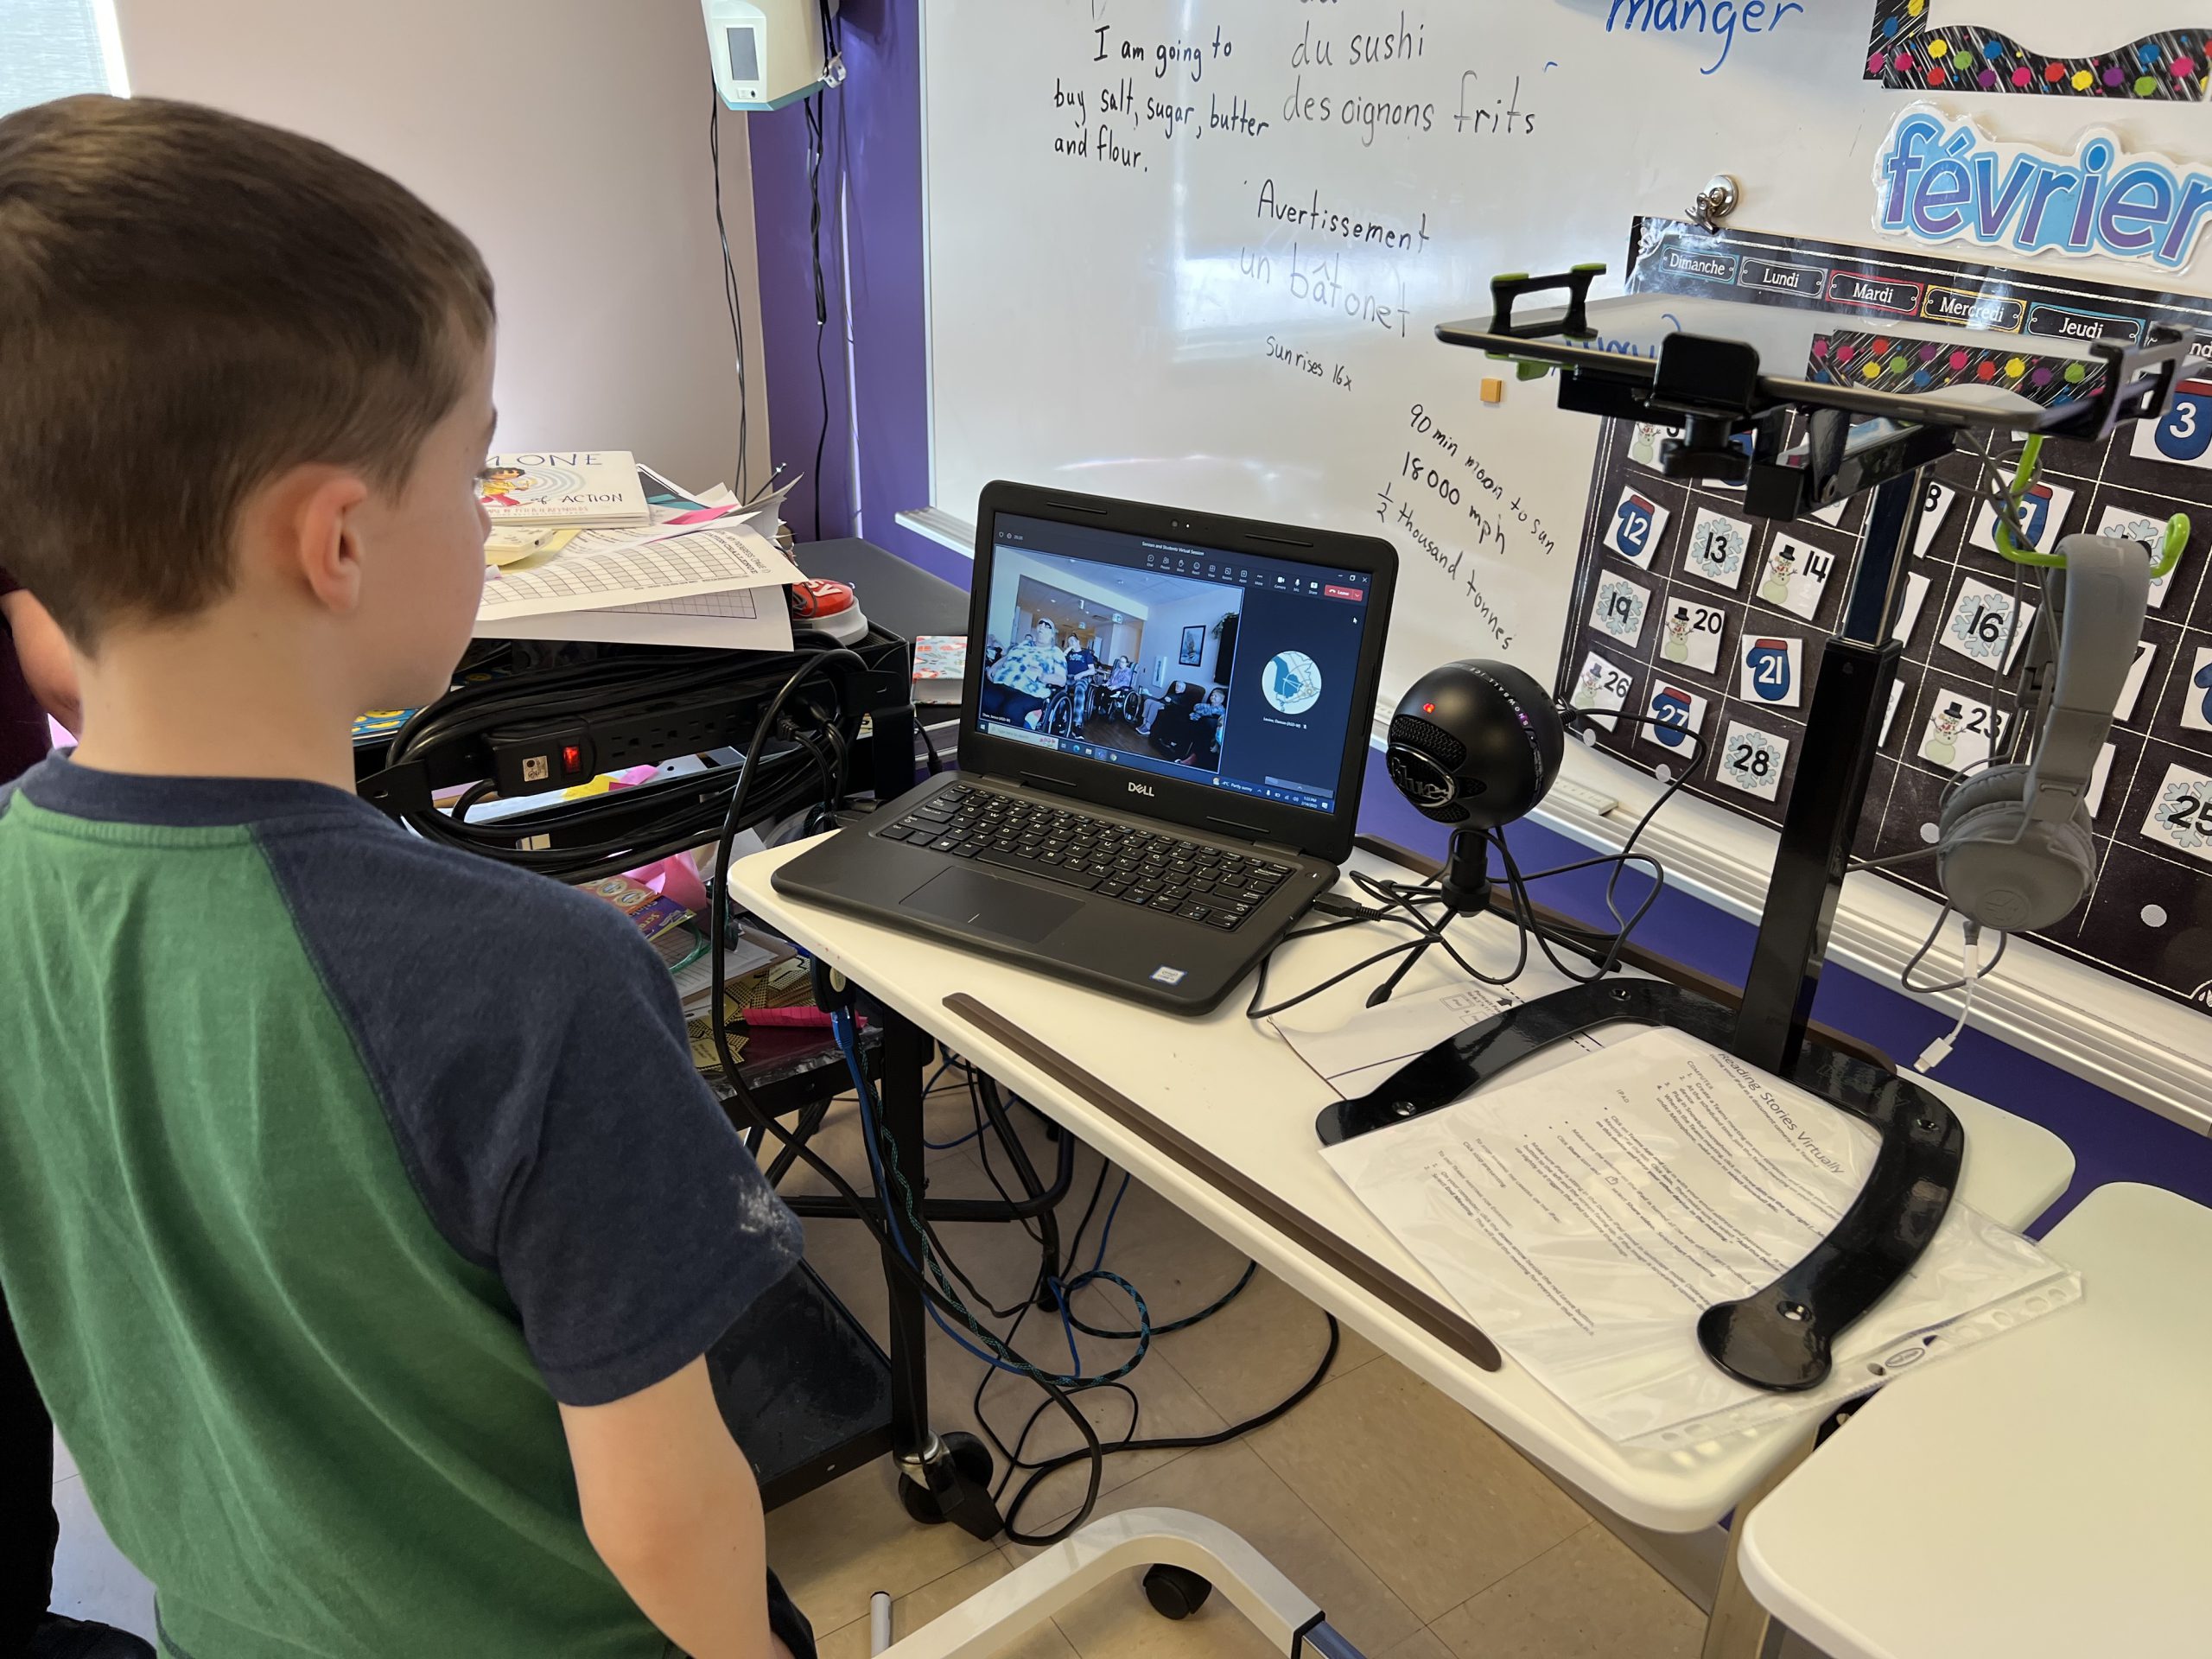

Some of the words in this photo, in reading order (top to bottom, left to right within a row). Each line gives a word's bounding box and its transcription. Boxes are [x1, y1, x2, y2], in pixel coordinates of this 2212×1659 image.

[1094, 25, 1109, 61] I
[1122, 41, 1144, 61] am
[1155, 40, 1202, 82] going
[1212, 25, 1232, 59] to
[1292, 20, 1333, 68] du
[1350, 11, 1426, 66] sushi
[1606, 0, 1804, 74] manger
[1054, 79, 1086, 128] buy
[1102, 79, 1140, 125] salt,
[1147, 96, 1203, 139] sugar,
[1210, 94, 1268, 137] butter
[1283, 75, 1332, 124] des
[1342, 89, 1433, 146] oignons
[1453, 70, 1535, 136] frits
[1054, 122, 1087, 159] and
[1096, 130, 1148, 173] flour.
[1257, 180, 1430, 253] Avertissement
[1885, 112, 2212, 264] février
[1240, 246, 1272, 285] un
[1289, 243, 1411, 338] bâtonet
[1669, 251, 1726, 277] Dimanche
[1763, 268, 1799, 289] Lundi
[1853, 282, 1893, 305] Mardi
[1940, 298, 2004, 323] Mercredi
[2058, 316, 2103, 340] Jeudi
[1266, 337, 1323, 378] Sunrises
[1332, 364, 1352, 391] 16x
[2170, 403, 2196, 438] 3
[517, 454, 602, 467] ONE
[1411, 404, 1431, 433] 90
[1432, 427, 1459, 457] min
[1465, 455, 1503, 499] moon
[1510, 498, 1529, 523] to
[1531, 519, 1554, 555] sun
[562, 493, 623, 503] ACTION
[724, 542, 758, 574] CHALLENGE
[1470, 505, 1504, 555] mph
[1624, 512, 1647, 543] 12
[1702, 531, 1727, 563] 13
[1802, 550, 1827, 582] 14
[1399, 502, 1464, 581] thousand
[1467, 570, 1518, 651] tonnes
[1607, 592, 1631, 624] 19
[1694, 610, 1722, 633] 20
[1759, 656, 1783, 684] 21
[1968, 606, 2003, 642] 16
[1488, 677, 1529, 727] SNOWBALL
[1605, 670, 1633, 698] 26
[1659, 703, 1688, 728] 27
[1732, 745, 1770, 776] 28
[1969, 708, 2004, 740] 23
[1128, 783, 1154, 797] DELL
[1392, 757, 1446, 799] Blue
[2167, 795, 2212, 836] 25
[1687, 1060, 1714, 1090] COMPUTER
[1664, 1093, 1678, 1109] When
[1680, 1114, 1690, 1124] the
[1688, 1123, 1704, 1141] Teams
[1671, 1090, 1683, 1103] Plug
[1685, 1106, 1707, 1130] Snowball
[1692, 1090, 1701, 1101] the
[1699, 1100, 1724, 1127] scheduled
[1742, 1147, 1752, 1156] the
[1751, 1156, 1770, 1172] Teams
[1766, 1170, 1790, 1187] meeting
[1695, 1082, 1711, 1099] Create
[1713, 1103, 1728, 1120] Teams
[1726, 1120, 1747, 1141] meeting
[1751, 1147, 1764, 1158] your
[1719, 1052, 1761, 1090] Reading
[1759, 1092, 1797, 1130] Stories
[1796, 1130, 1845, 1173] Virtually
[1462, 1141, 1474, 1153] Click
[1471, 1152, 1484, 1163] stop
[1656, 1097, 1671, 1113] under
[1697, 1142, 1711, 1155] make
[1709, 1155, 1722, 1166] sure
[1726, 1171, 1744, 1185] select
[1444, 1185, 1456, 1196] End
[1509, 1255, 1531, 1275] meeting
[1536, 1281, 1561, 1306] everyone
[1446, 1178, 1460, 1189] your
[1497, 1231, 1513, 1246] down
[1510, 1245, 1528, 1260] arrow
[1524, 1258, 1543, 1275] beside
[1541, 1275, 1552, 1286] the
[1550, 1284, 1562, 1294] red
